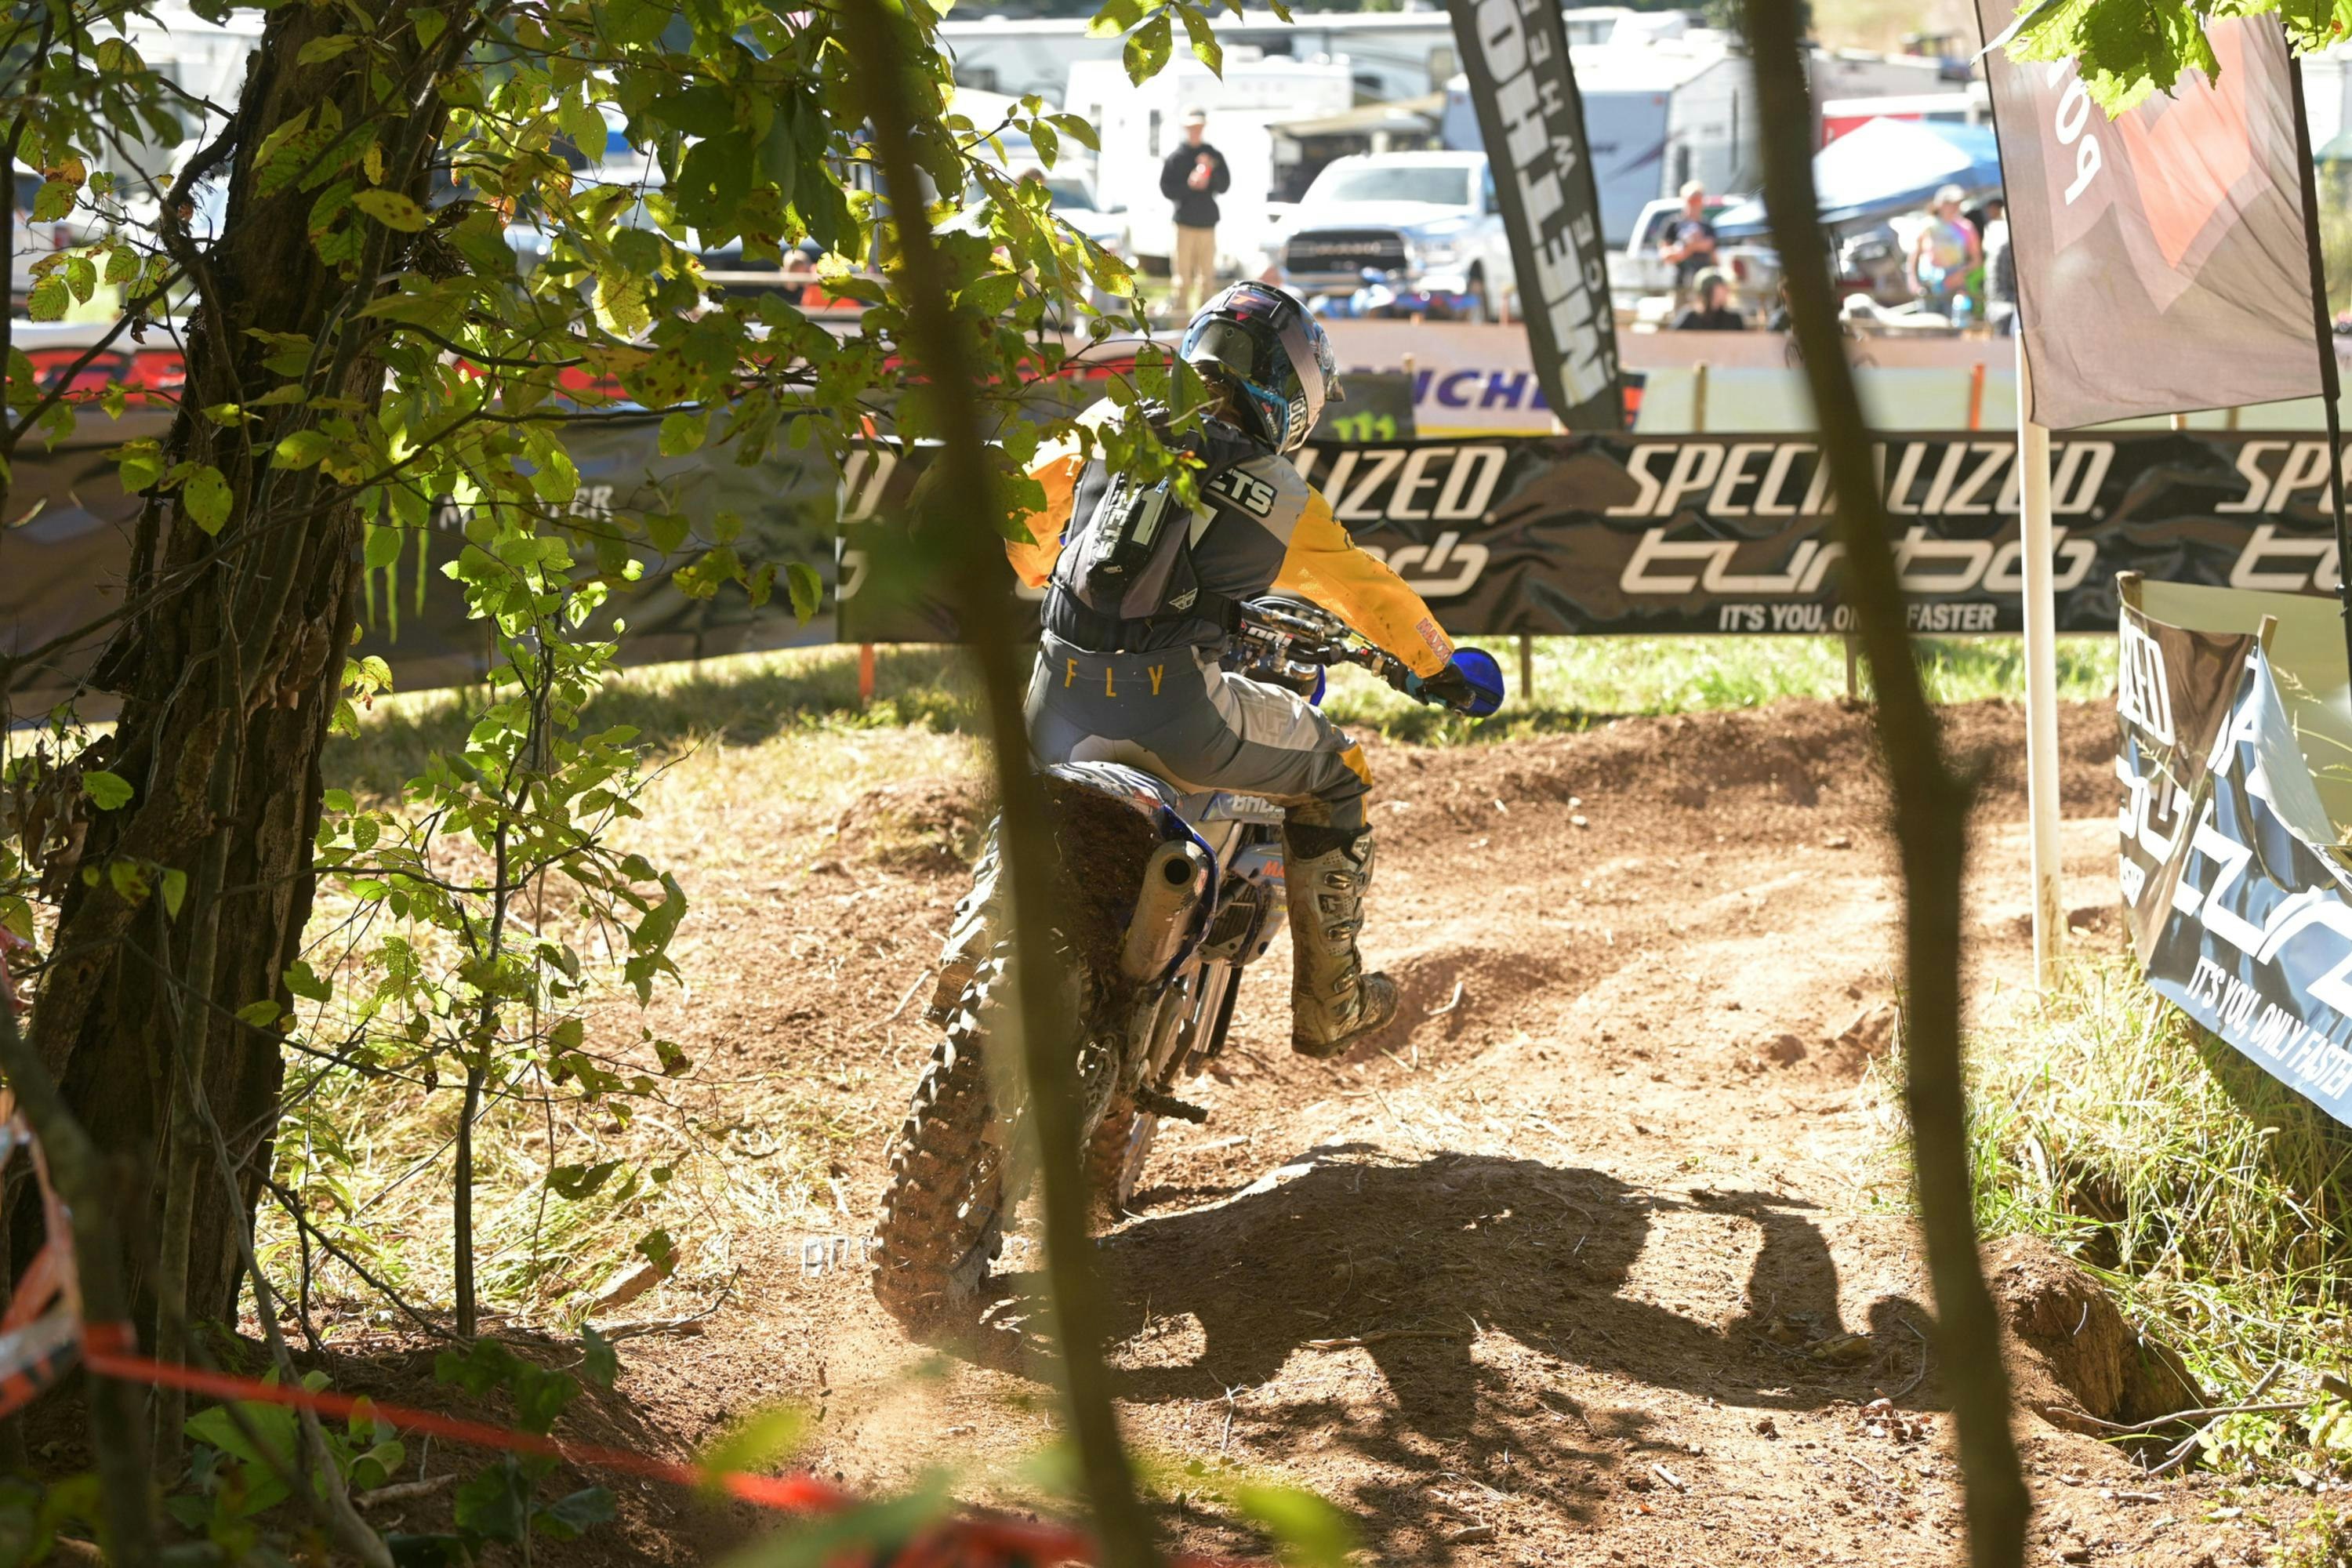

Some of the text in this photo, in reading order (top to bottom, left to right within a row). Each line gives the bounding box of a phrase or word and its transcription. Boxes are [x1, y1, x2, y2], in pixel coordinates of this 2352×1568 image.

[2047, 53, 2102, 206] 09
[1468, 0, 1608, 409] METHO
[1719, 604, 1766, 632] IT'S
[1907, 603, 1998, 631] FASTER
[1064, 657, 1164, 698] FLY
[2183, 954, 2227, 1009] IT'S
[2249, 1002, 2310, 1062] ONLY
